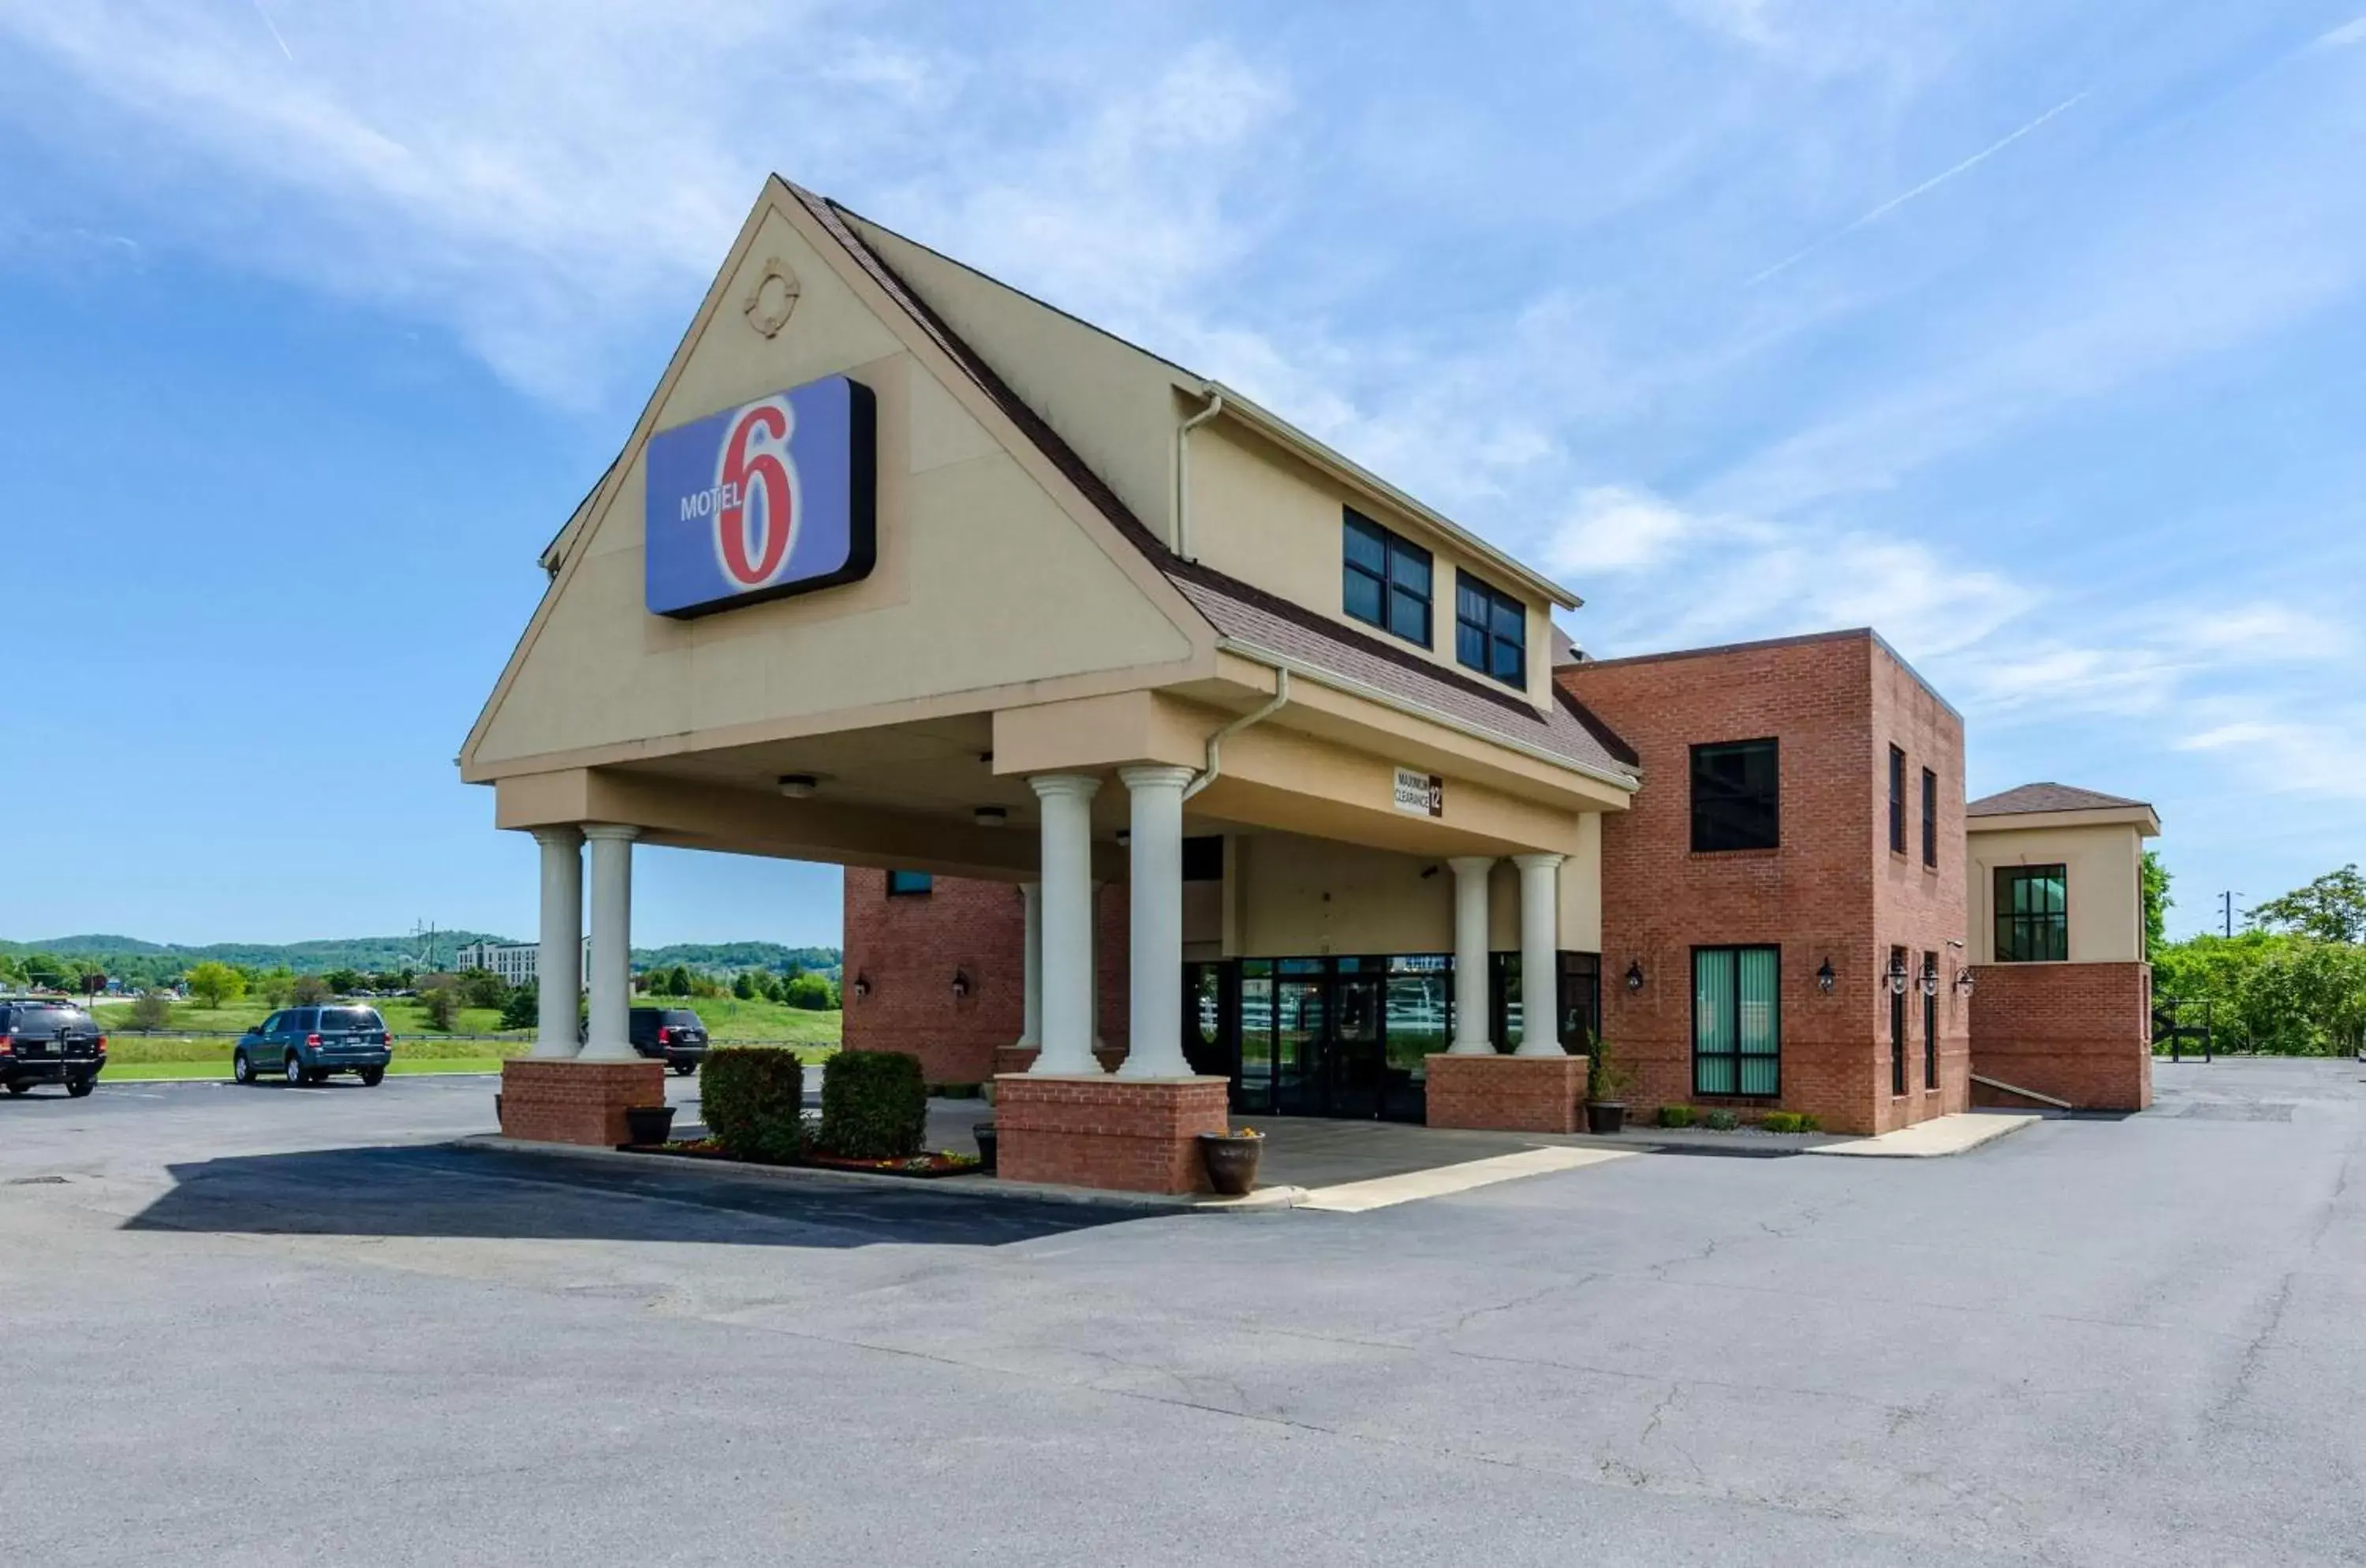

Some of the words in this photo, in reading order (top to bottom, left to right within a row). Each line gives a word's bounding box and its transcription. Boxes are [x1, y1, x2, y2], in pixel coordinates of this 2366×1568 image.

[680, 482, 742, 522] MOTEL
[719, 405, 792, 584] 6
[1395, 788, 1428, 808] CLEARANCE
